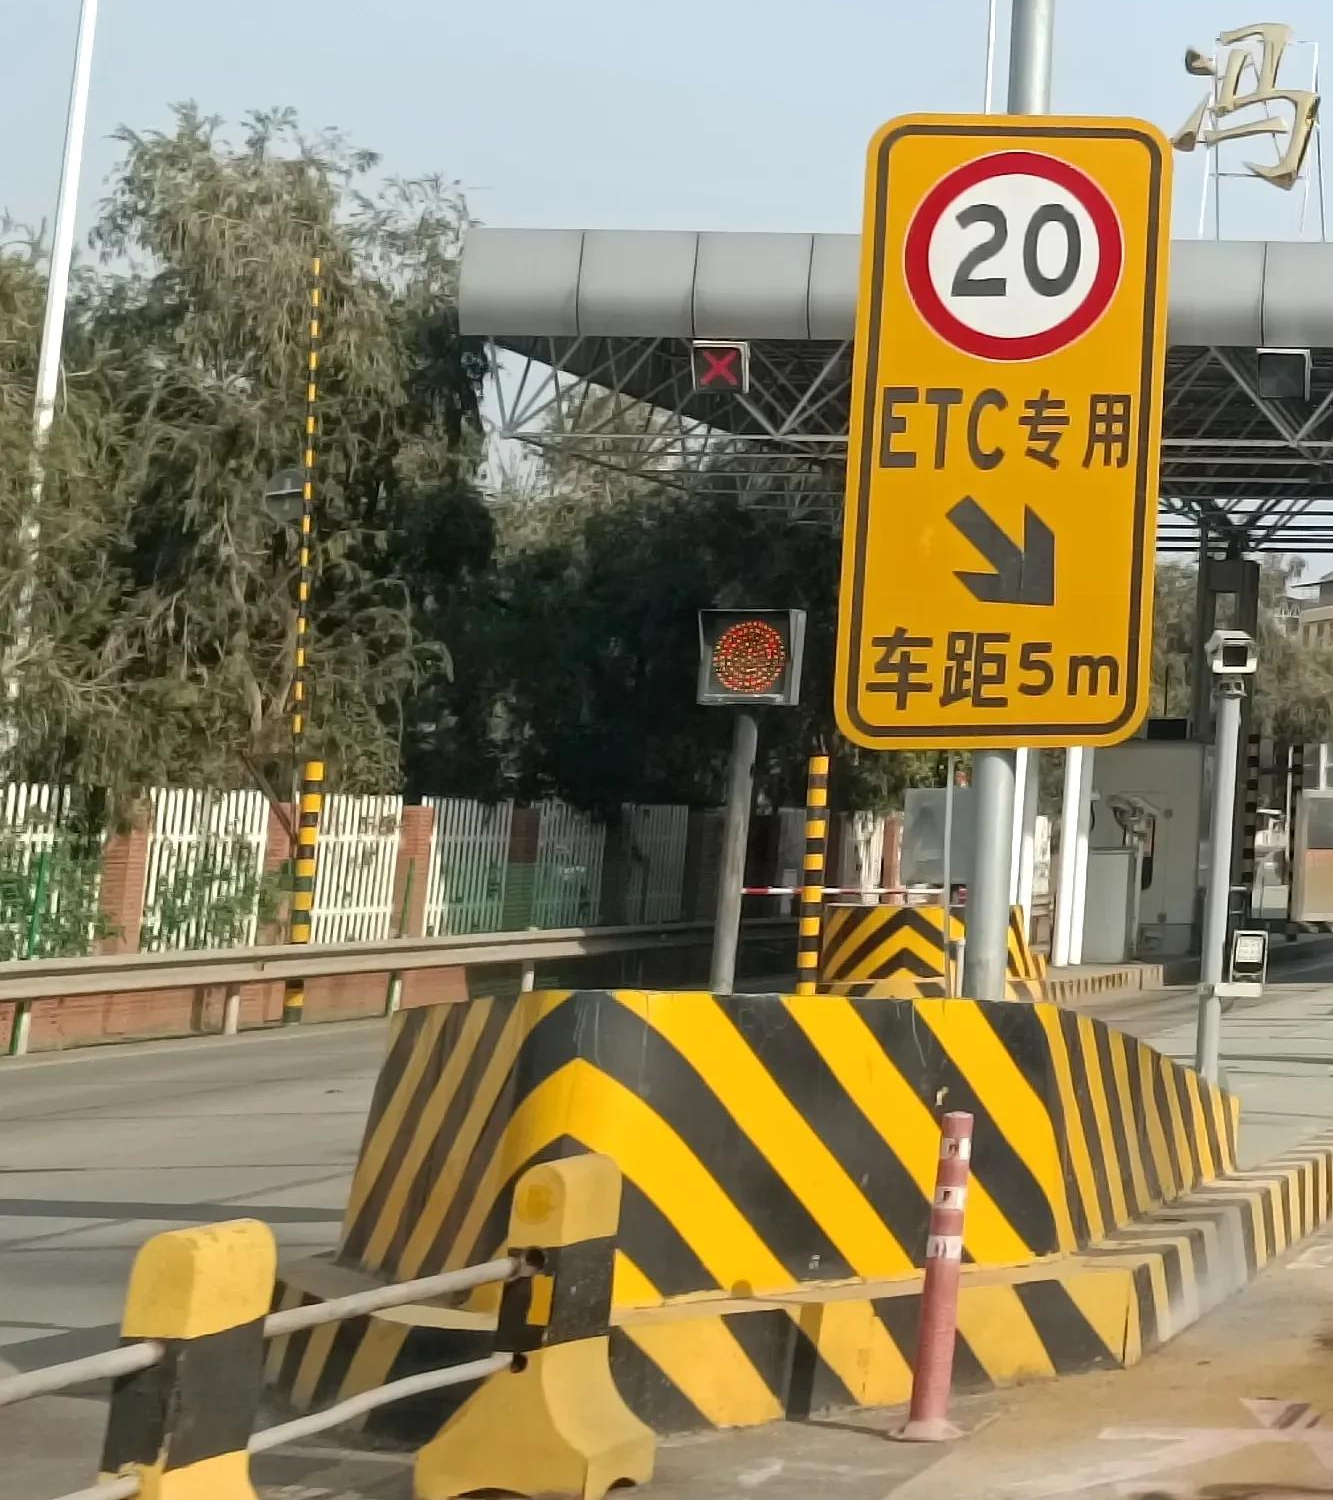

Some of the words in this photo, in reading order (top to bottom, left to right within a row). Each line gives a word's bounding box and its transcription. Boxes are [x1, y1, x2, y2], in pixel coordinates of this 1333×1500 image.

[951, 202, 1082, 298] 20
[878, 386, 1132, 472] ETC专用
[866, 626, 1121, 711] 车距5m
